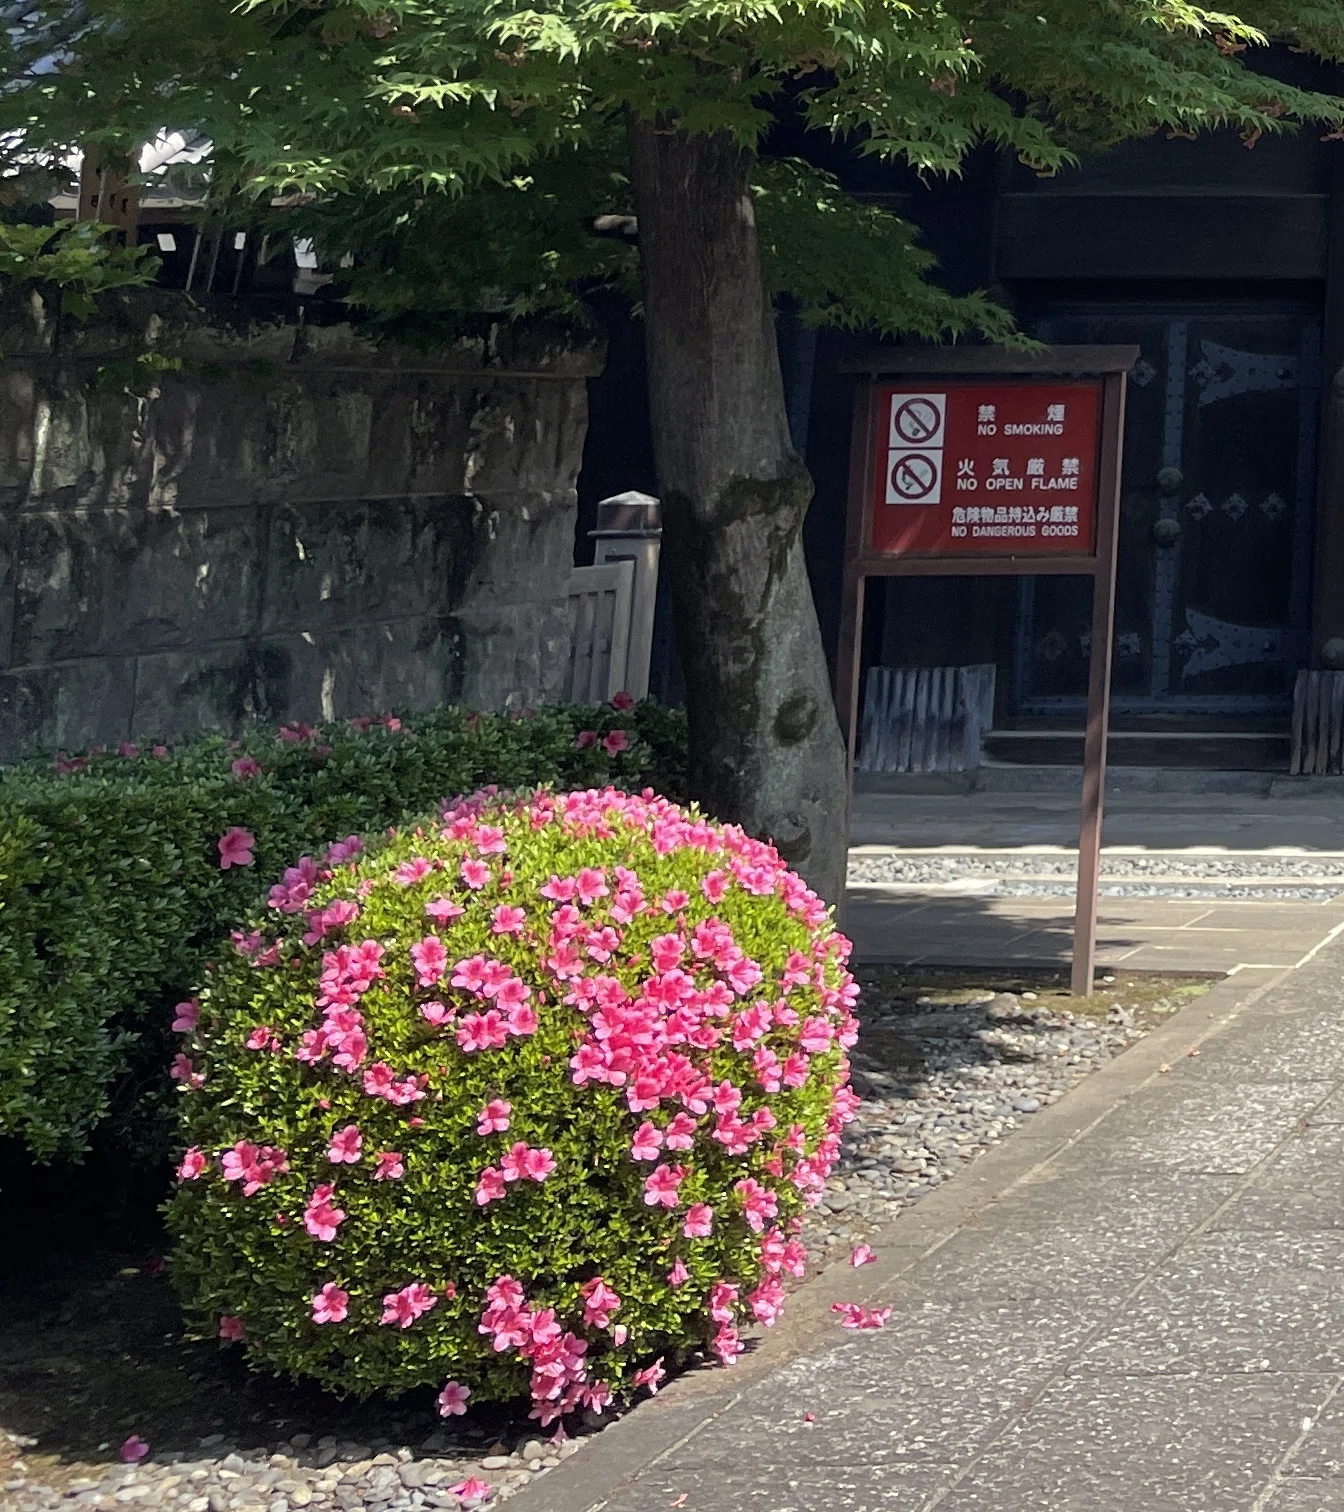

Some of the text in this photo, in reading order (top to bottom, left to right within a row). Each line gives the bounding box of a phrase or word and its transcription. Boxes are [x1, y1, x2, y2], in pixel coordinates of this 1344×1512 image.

[978, 404, 1065, 421] 禁煙
[977, 423, 1063, 436] NO SMOKING
[957, 458, 1079, 475] 火気厳禁
[956, 477, 1078, 490] NO OPEN FLAME
[952, 506, 1079, 523] 危険物品持込み厳禁
[951, 525, 1079, 537] NO DANGEROUS GOODS
